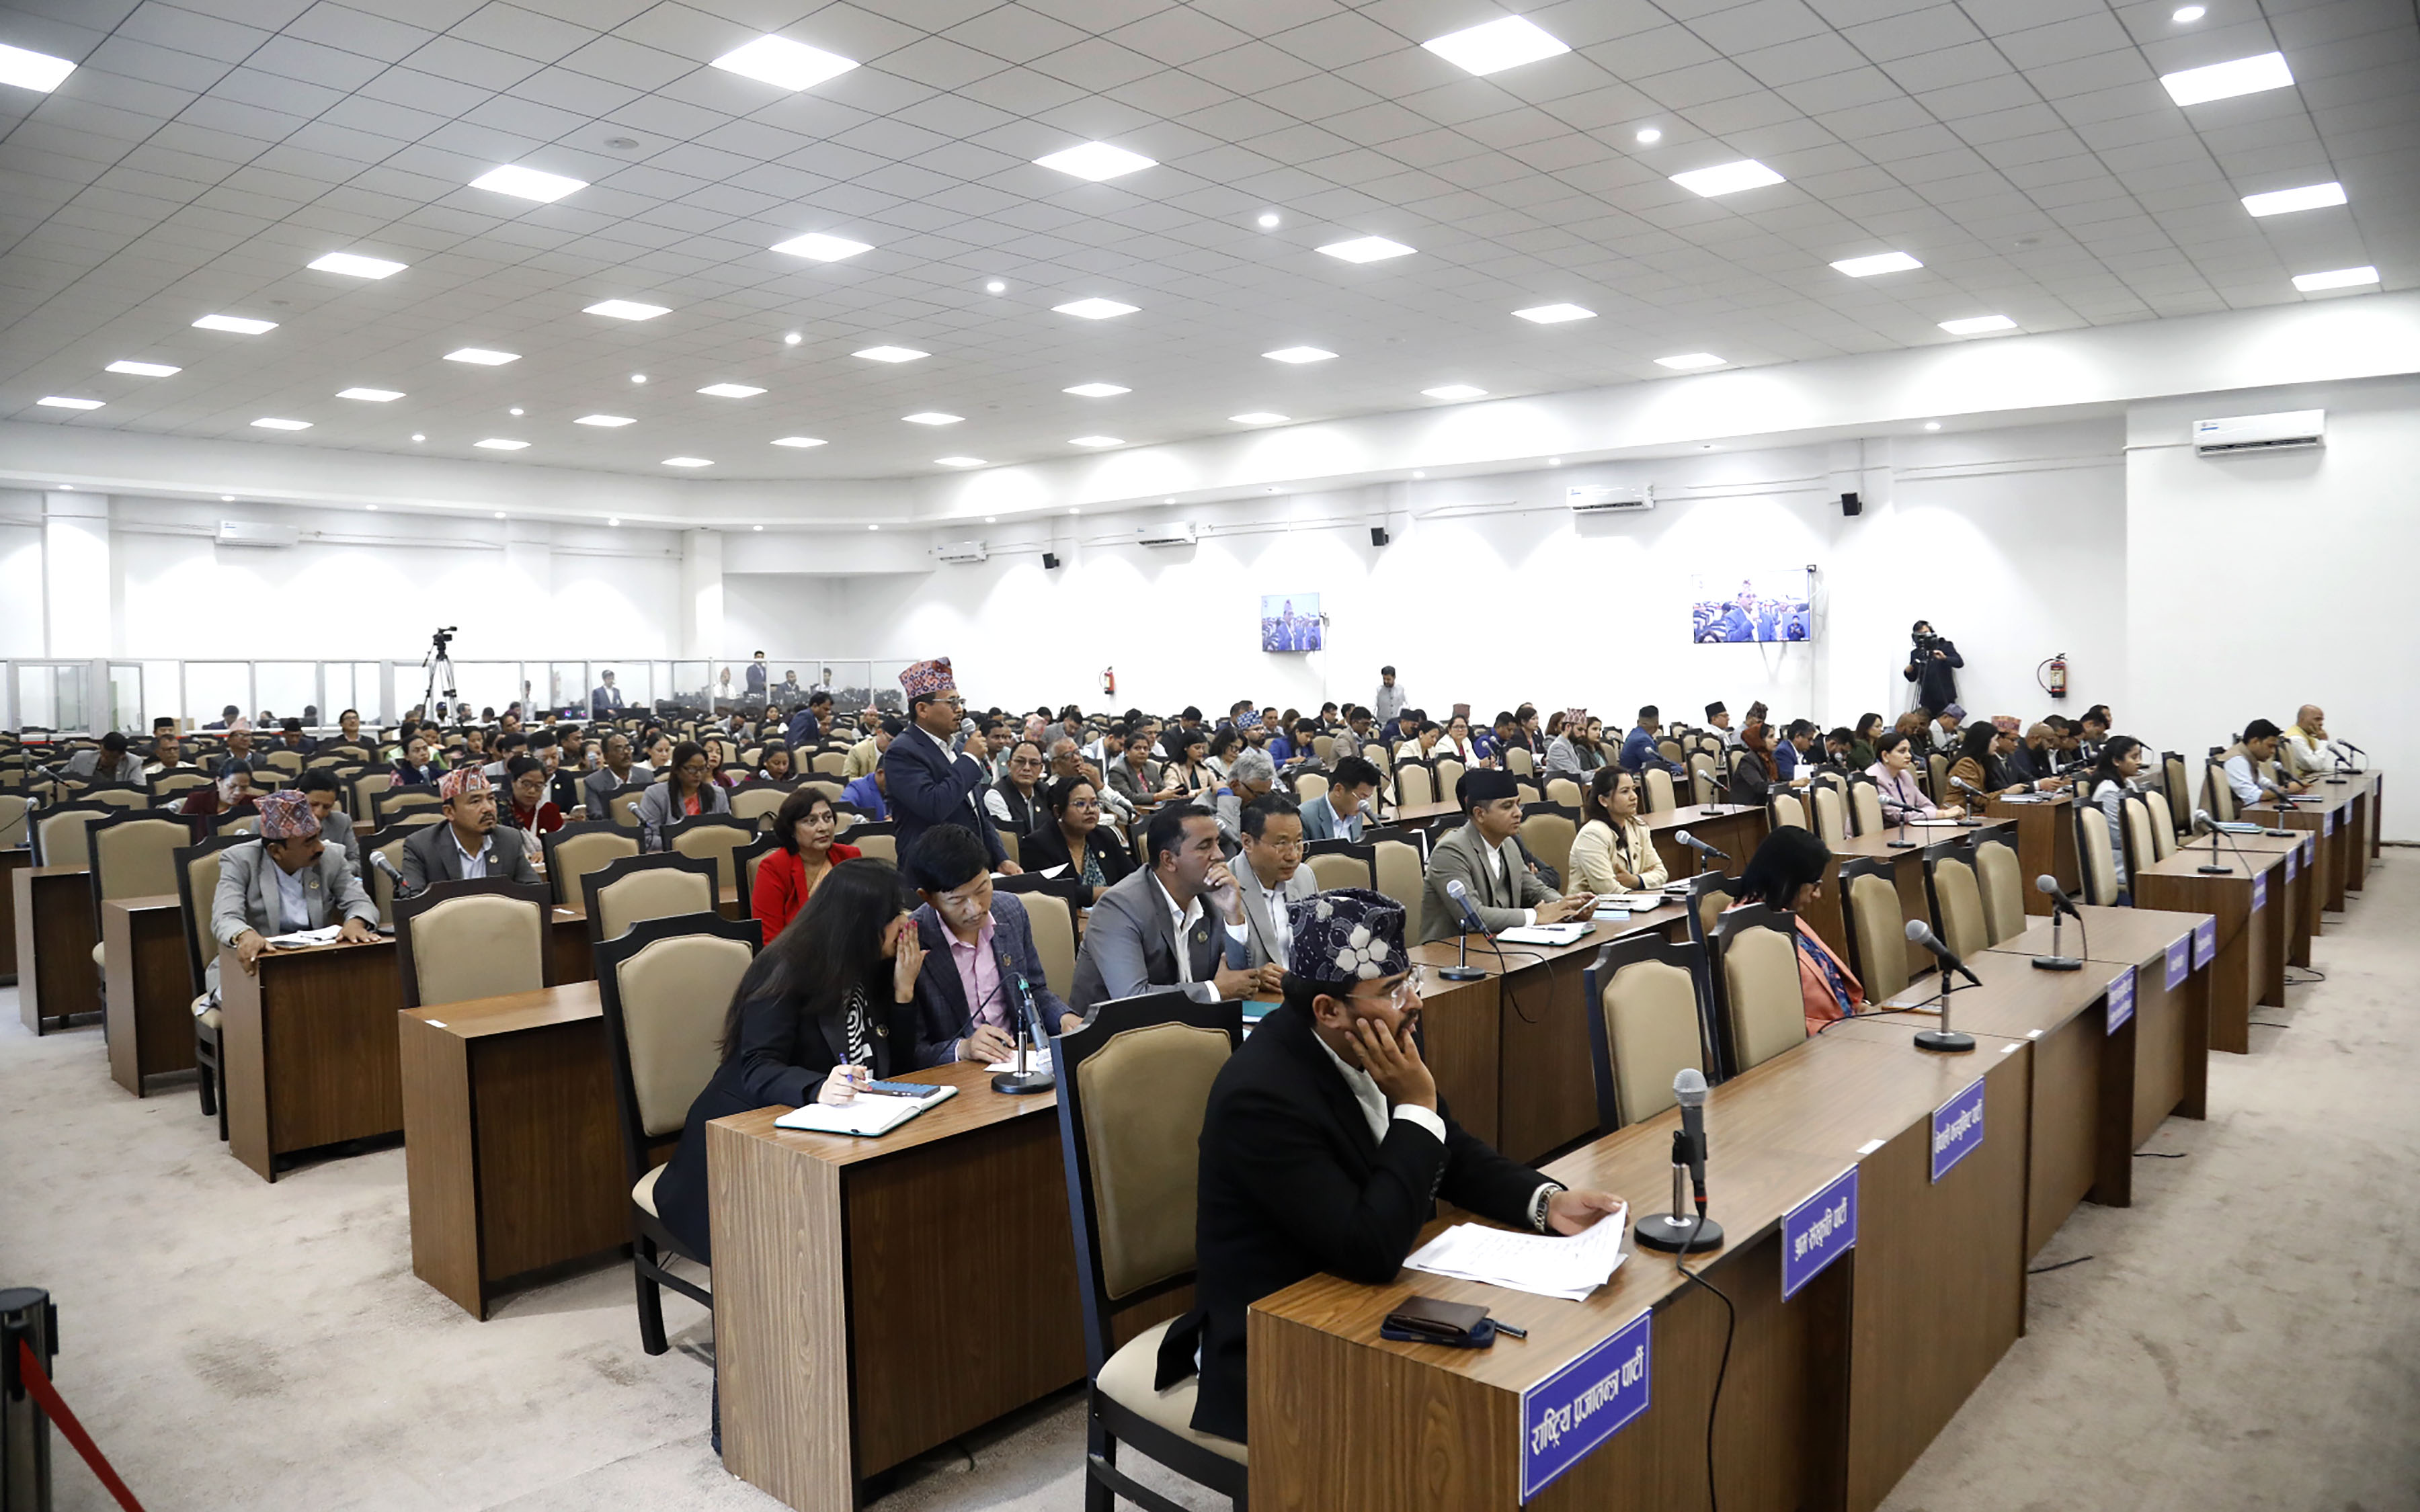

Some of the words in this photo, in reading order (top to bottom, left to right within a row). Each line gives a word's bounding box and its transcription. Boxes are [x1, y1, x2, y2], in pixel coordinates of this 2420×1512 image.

[1833, 1197, 1847, 1228] पार्टी
[1531, 1404, 1572, 1456] राष्ट्रिय
[1574, 1369, 1620, 1429] प्रजातन्त्र
[1622, 1345, 1644, 1387] पार्टी
